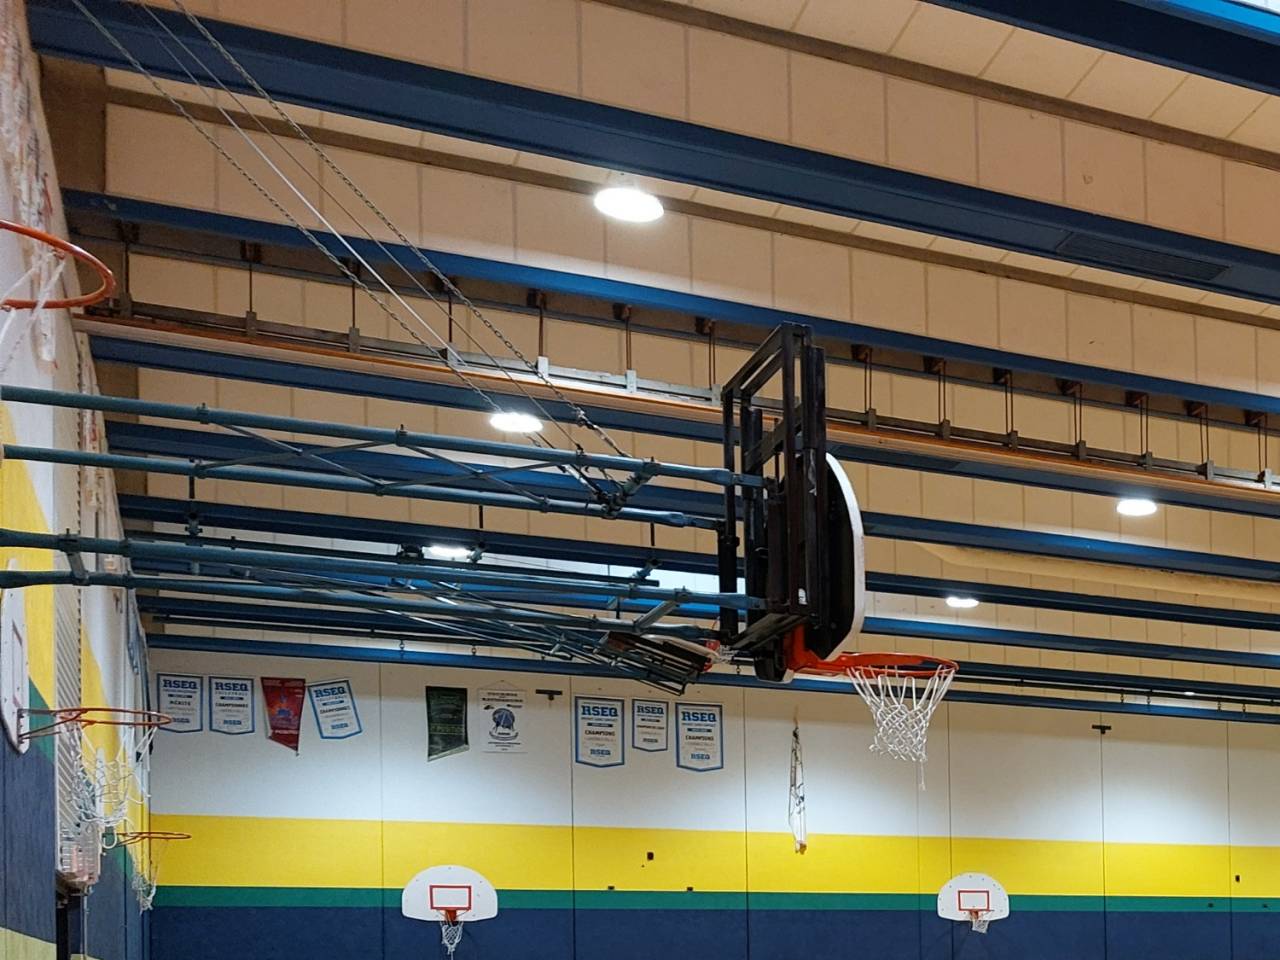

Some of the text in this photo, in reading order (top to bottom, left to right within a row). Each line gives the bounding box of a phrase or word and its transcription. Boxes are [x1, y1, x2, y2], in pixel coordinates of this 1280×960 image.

[163, 679, 198, 689] RSEQ
[215, 681, 249, 691] RSEQ
[314, 687, 347, 698] RSEQ
[581, 705, 618, 716] RSEQ
[637, 705, 664, 715] RSEQ
[681, 711, 716, 722] RSEQ
